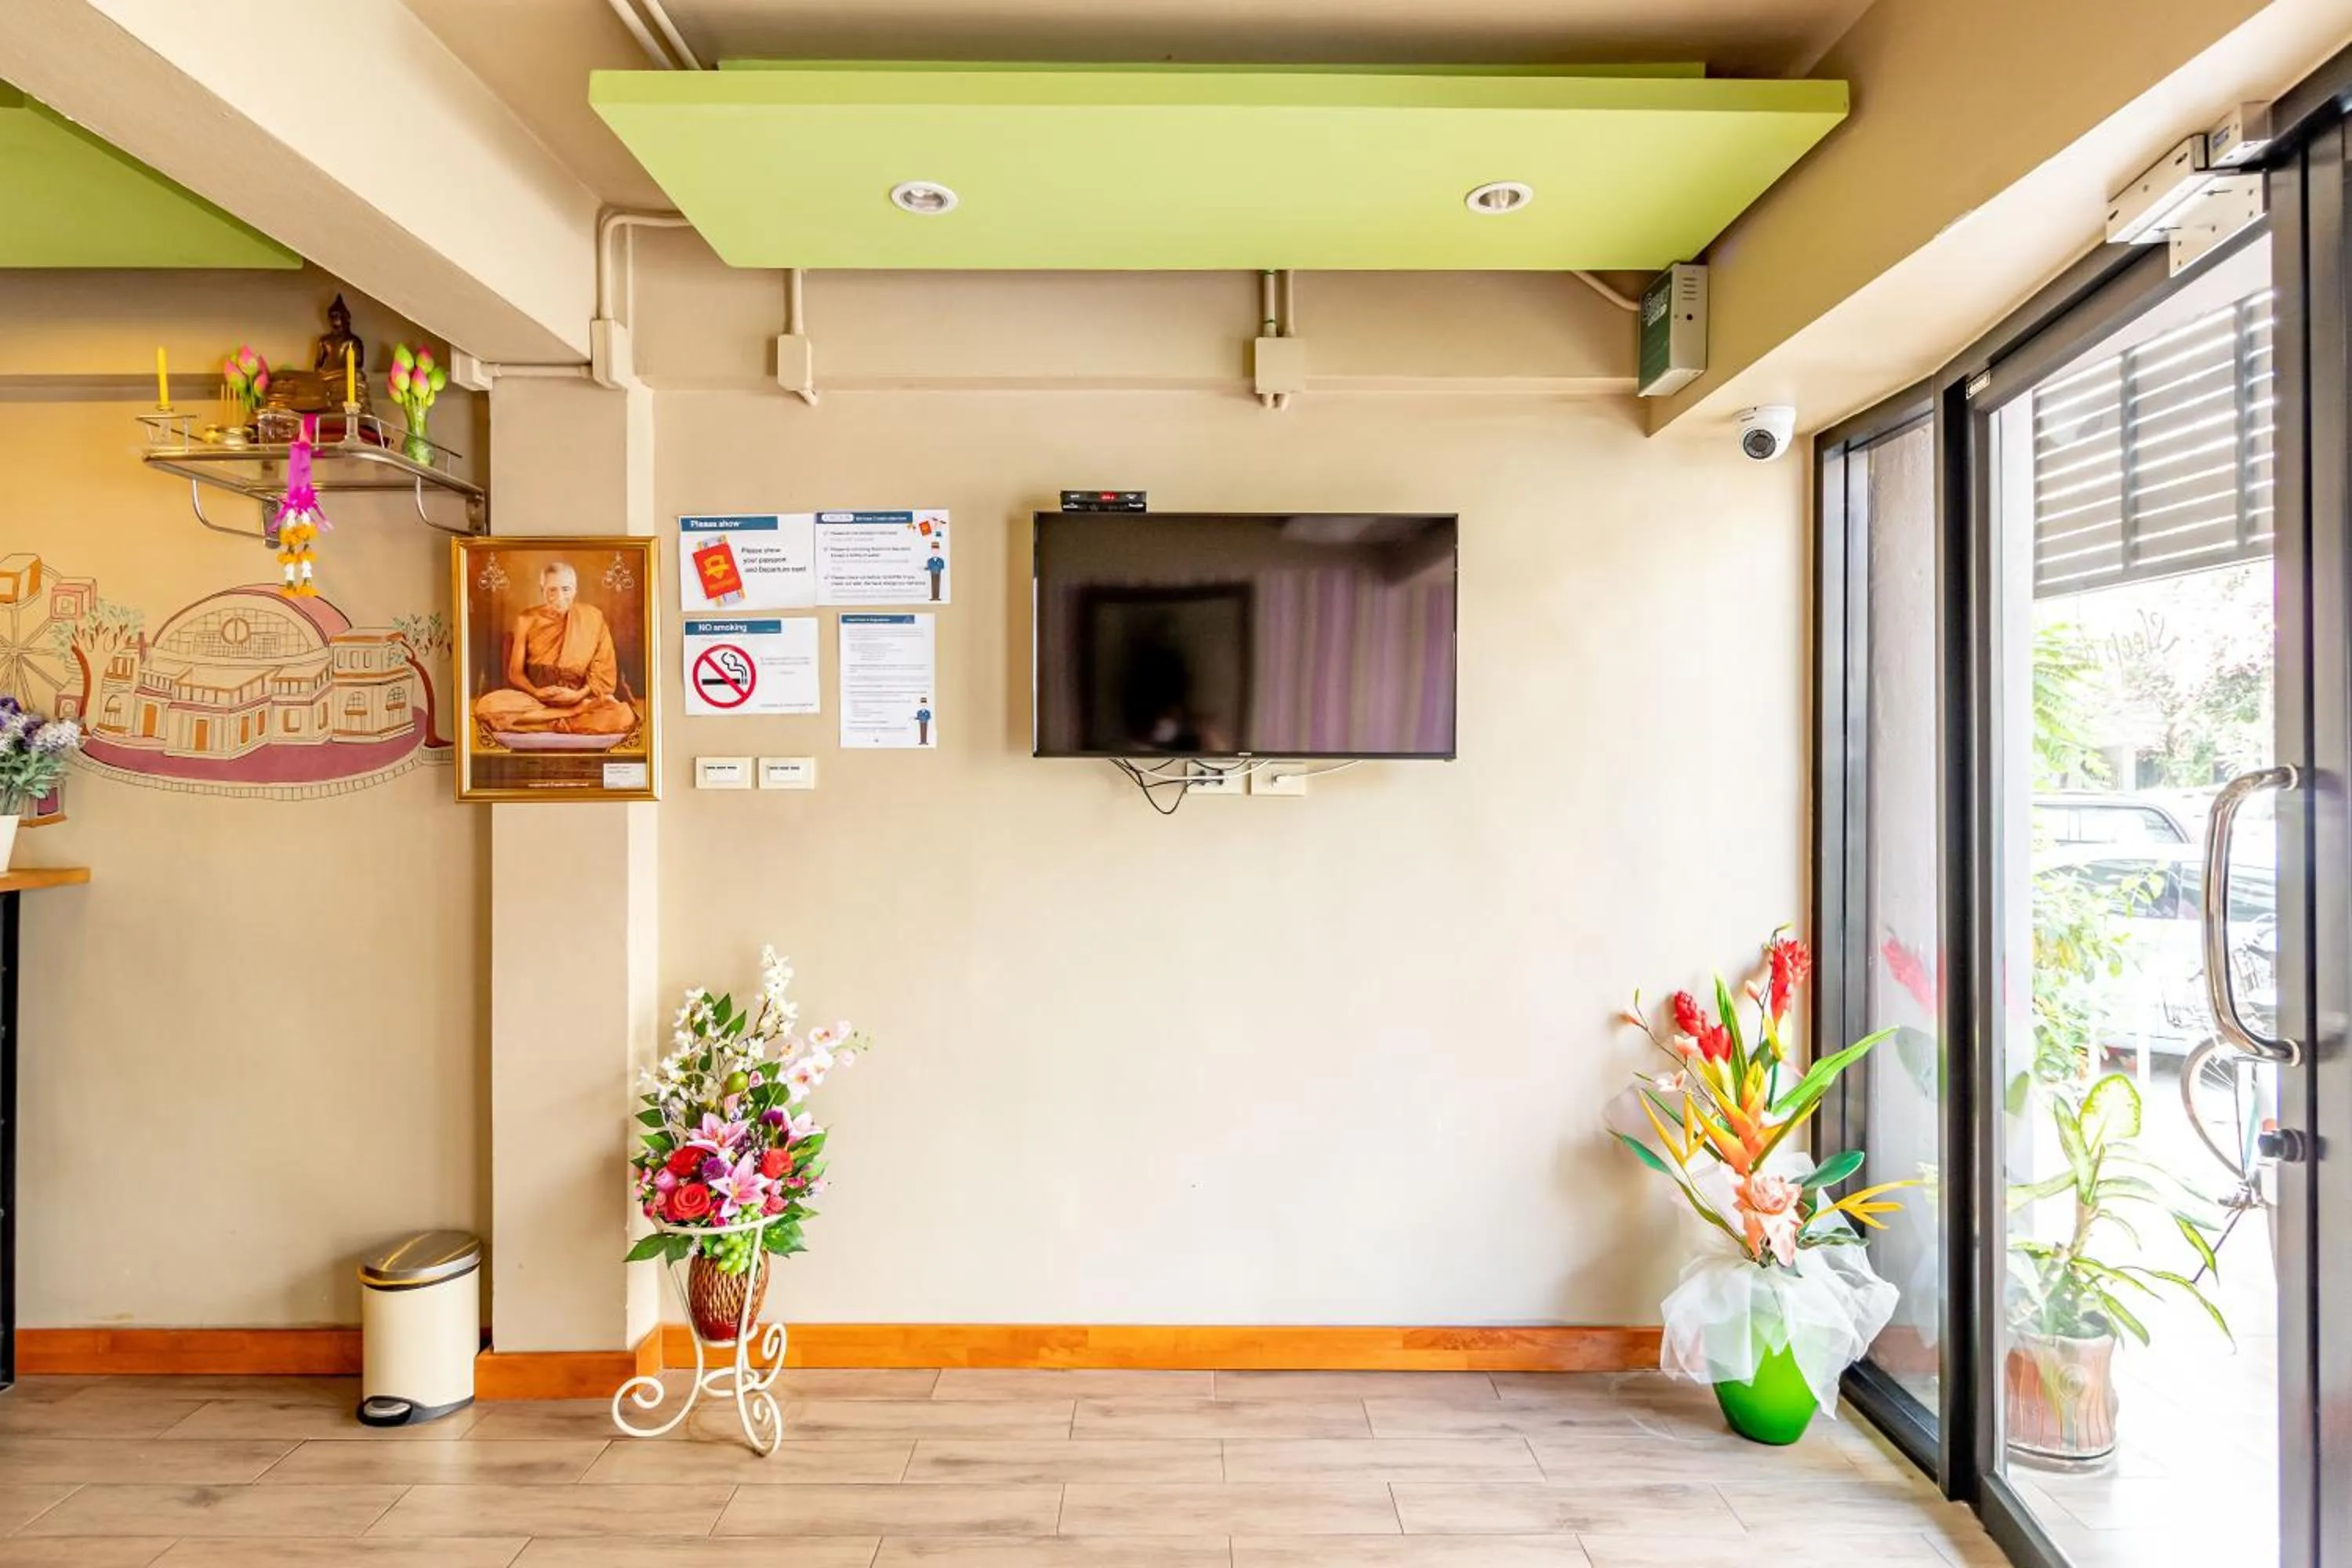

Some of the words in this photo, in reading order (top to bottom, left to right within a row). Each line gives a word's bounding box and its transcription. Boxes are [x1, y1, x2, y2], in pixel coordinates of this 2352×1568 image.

[690, 519, 717, 528] Please
[719, 519, 740, 528] show
[698, 623, 713, 632] NO
[713, 622, 747, 633] smoking
